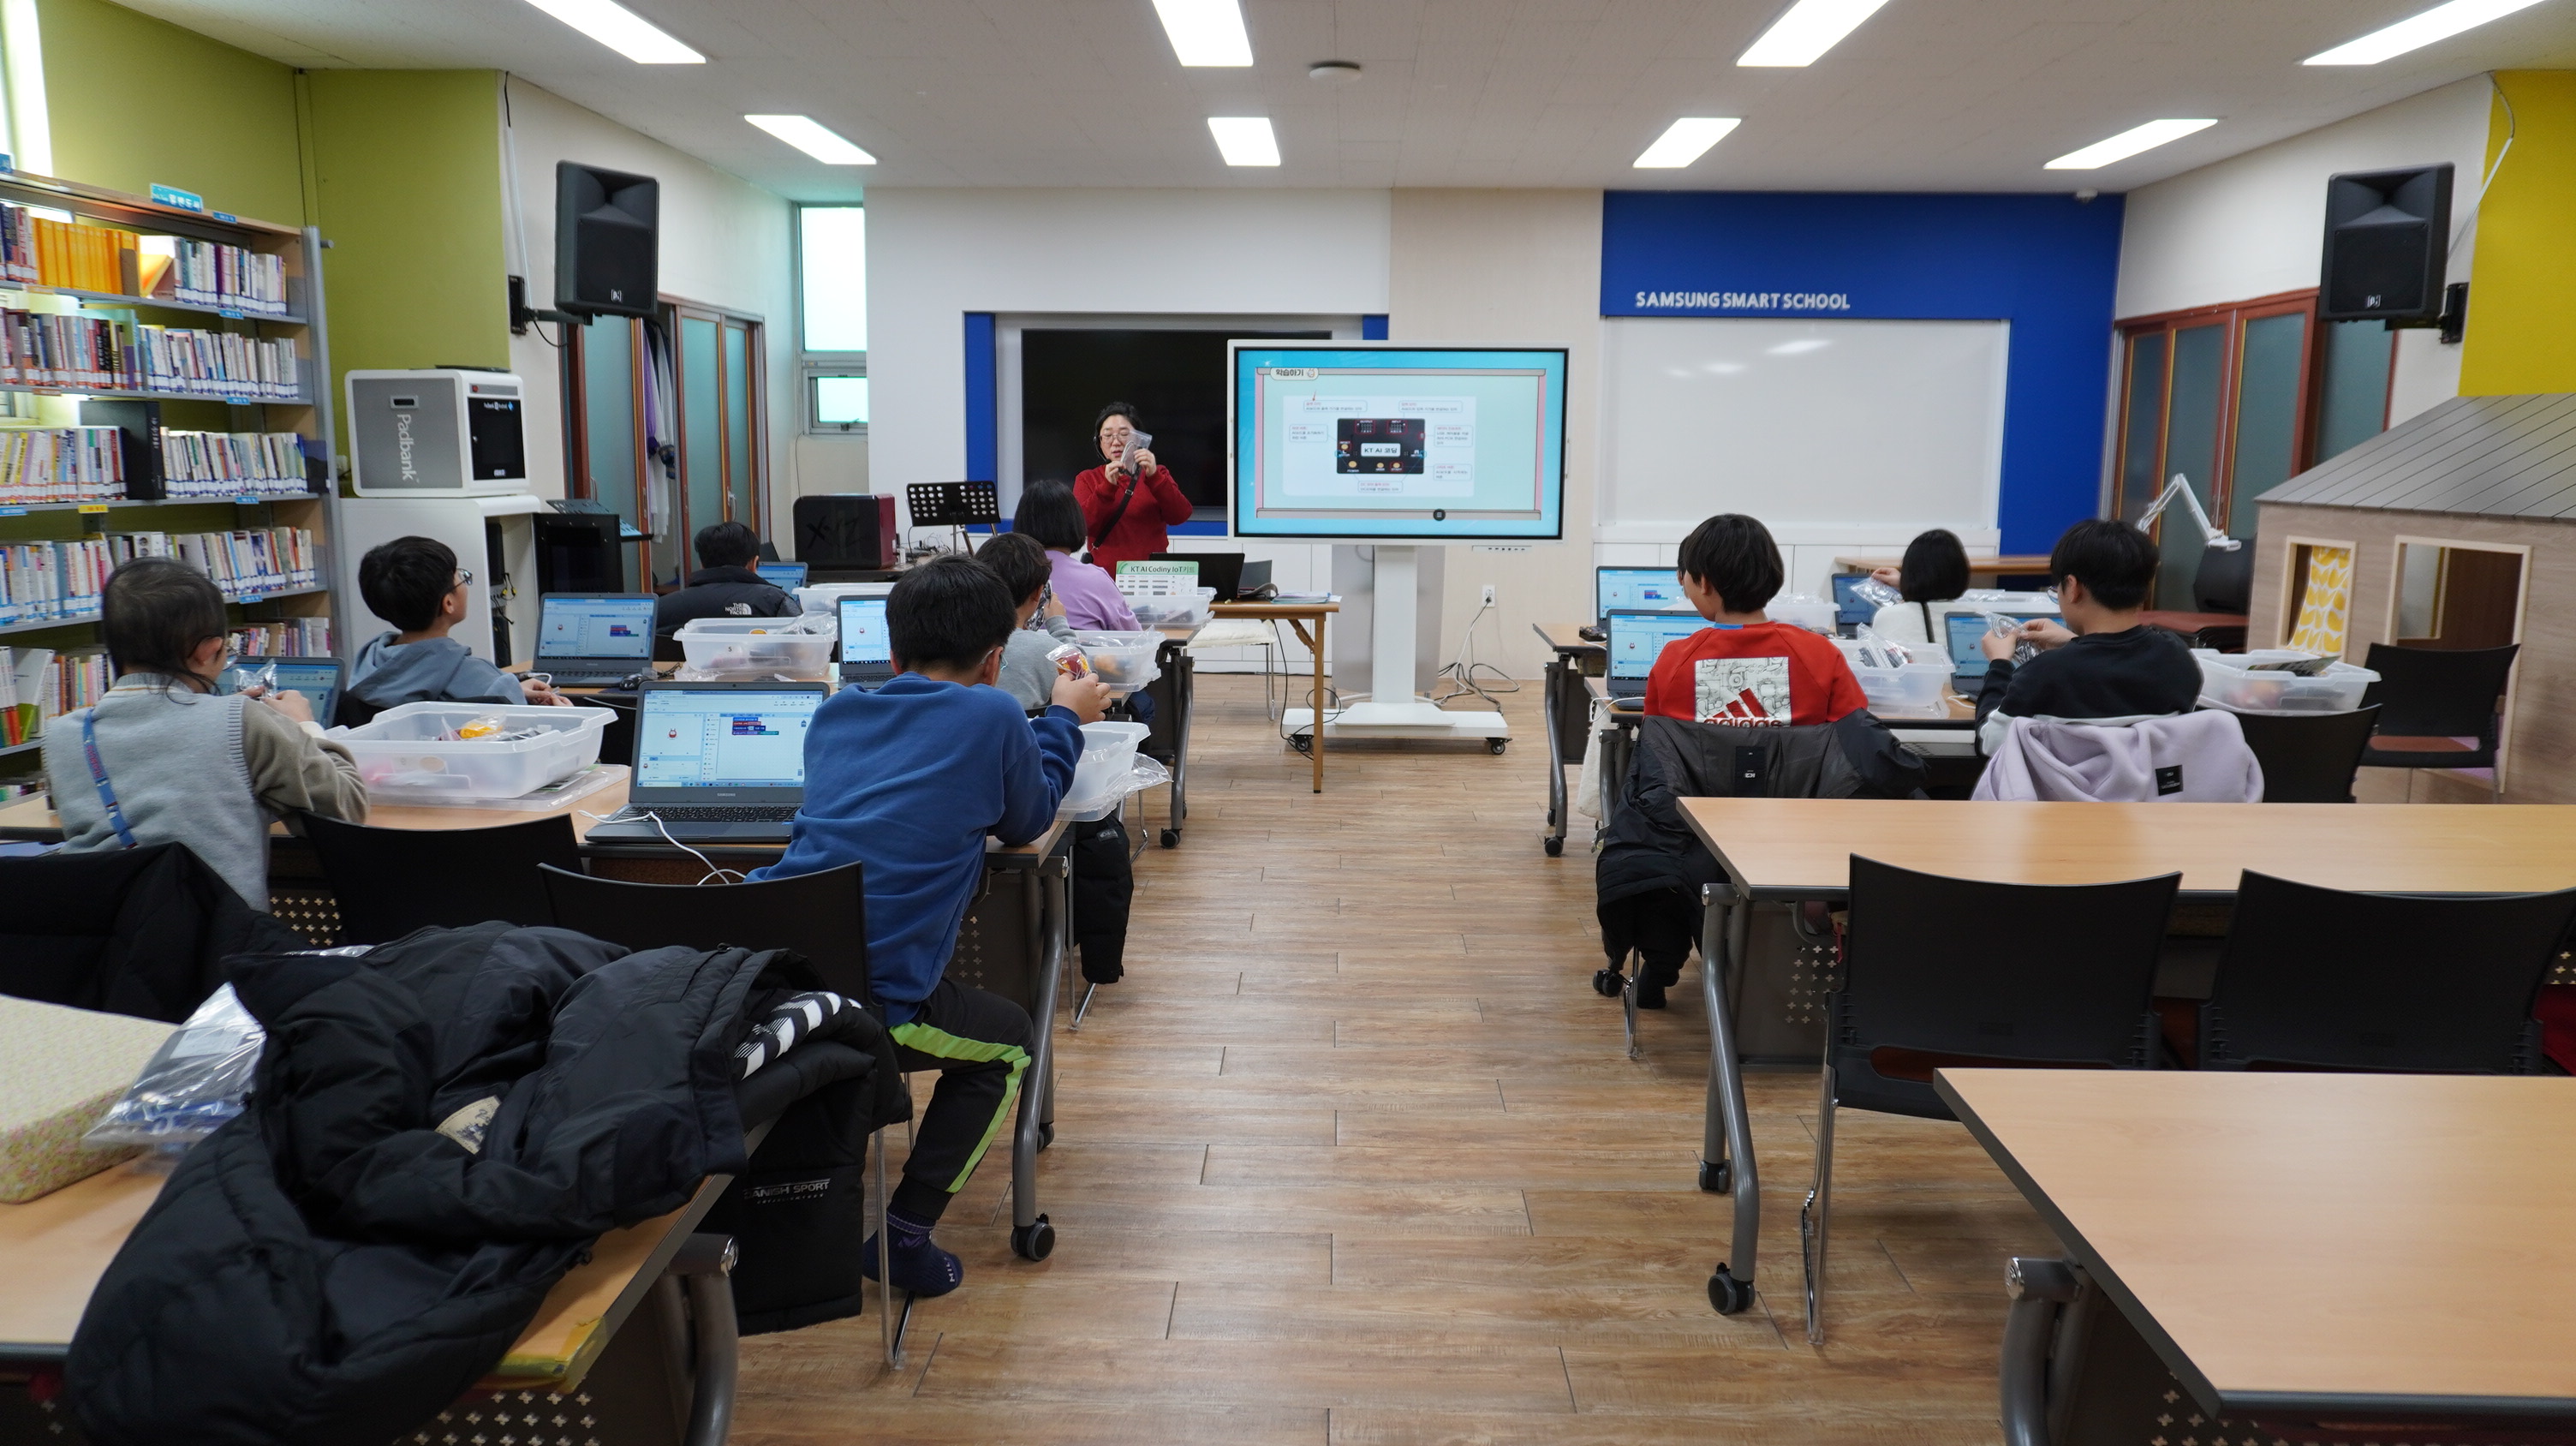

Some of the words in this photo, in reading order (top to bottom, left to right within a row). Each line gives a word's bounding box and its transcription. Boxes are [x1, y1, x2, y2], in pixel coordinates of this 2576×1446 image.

[1636, 291, 1720, 308] SAMSUNG
[1722, 292, 1780, 308] SMART
[1783, 293, 1851, 309] SCHOOL
[396, 414, 418, 481] Padbank
[793, 1181, 830, 1193] SPORT
